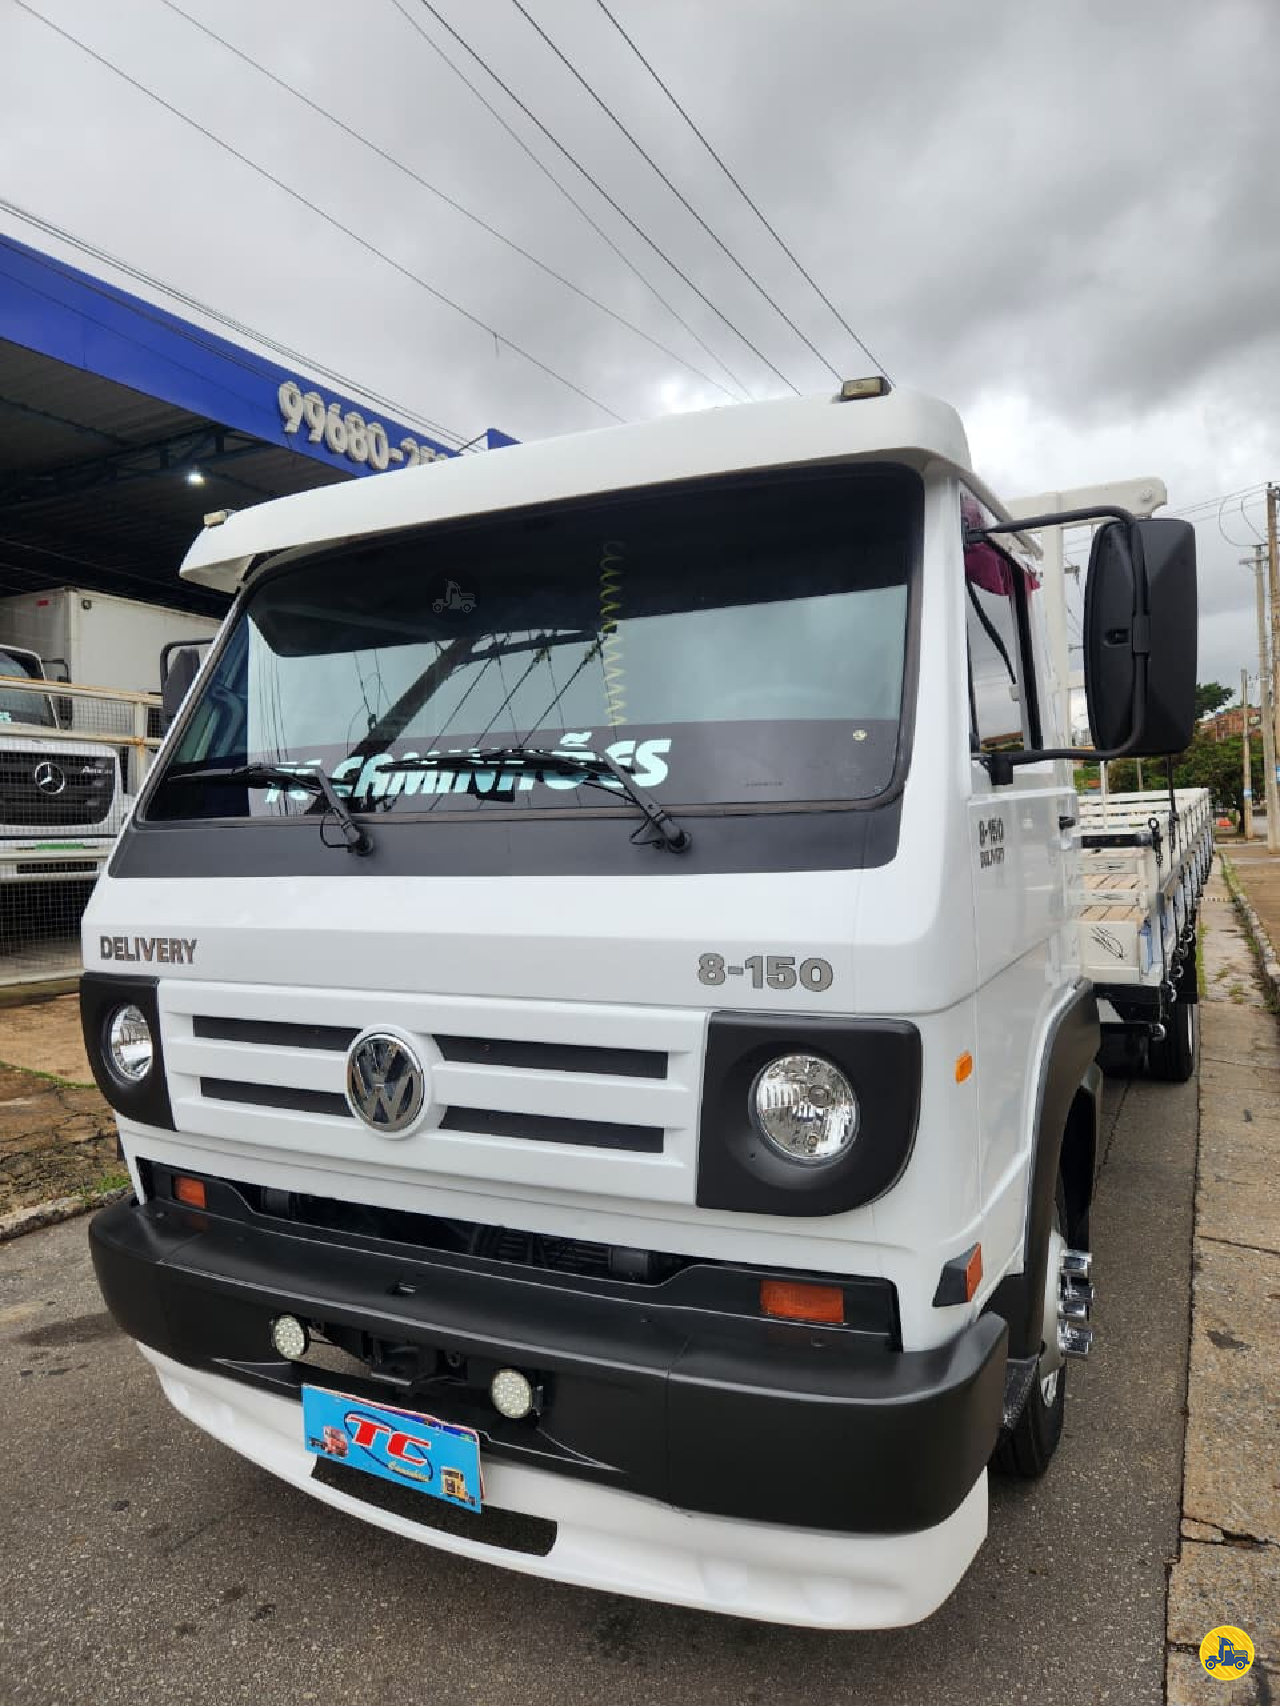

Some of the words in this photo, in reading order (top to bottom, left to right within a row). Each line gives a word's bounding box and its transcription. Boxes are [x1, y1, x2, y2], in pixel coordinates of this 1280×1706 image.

[278, 380, 449, 470] 99680-2
[100, 936, 197, 964] DELIVERY
[699, 953, 833, 992] 8-150
[346, 1413, 432, 1466] TC
